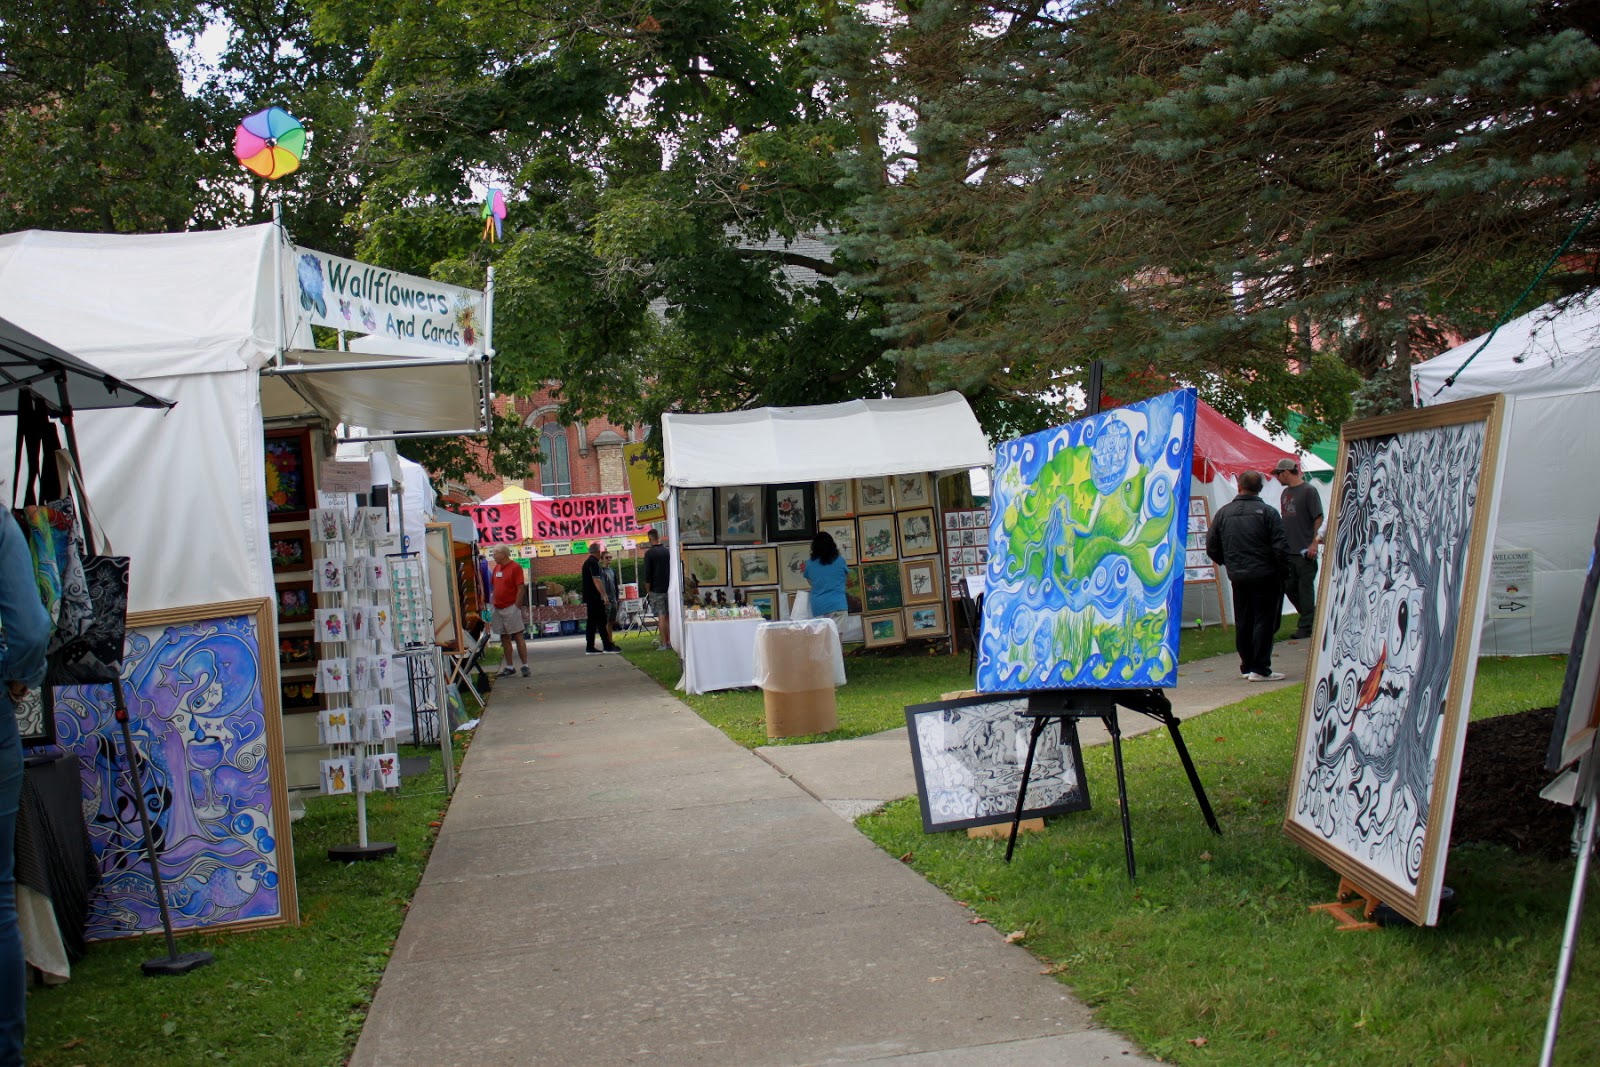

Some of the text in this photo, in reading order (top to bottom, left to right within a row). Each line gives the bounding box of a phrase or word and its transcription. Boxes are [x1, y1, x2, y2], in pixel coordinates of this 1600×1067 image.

[327, 260, 449, 315] Wallflowers
[386, 312, 460, 347] And Cards
[550, 498, 628, 518] GOURMET
[537, 516, 644, 537] SANDWICHE
